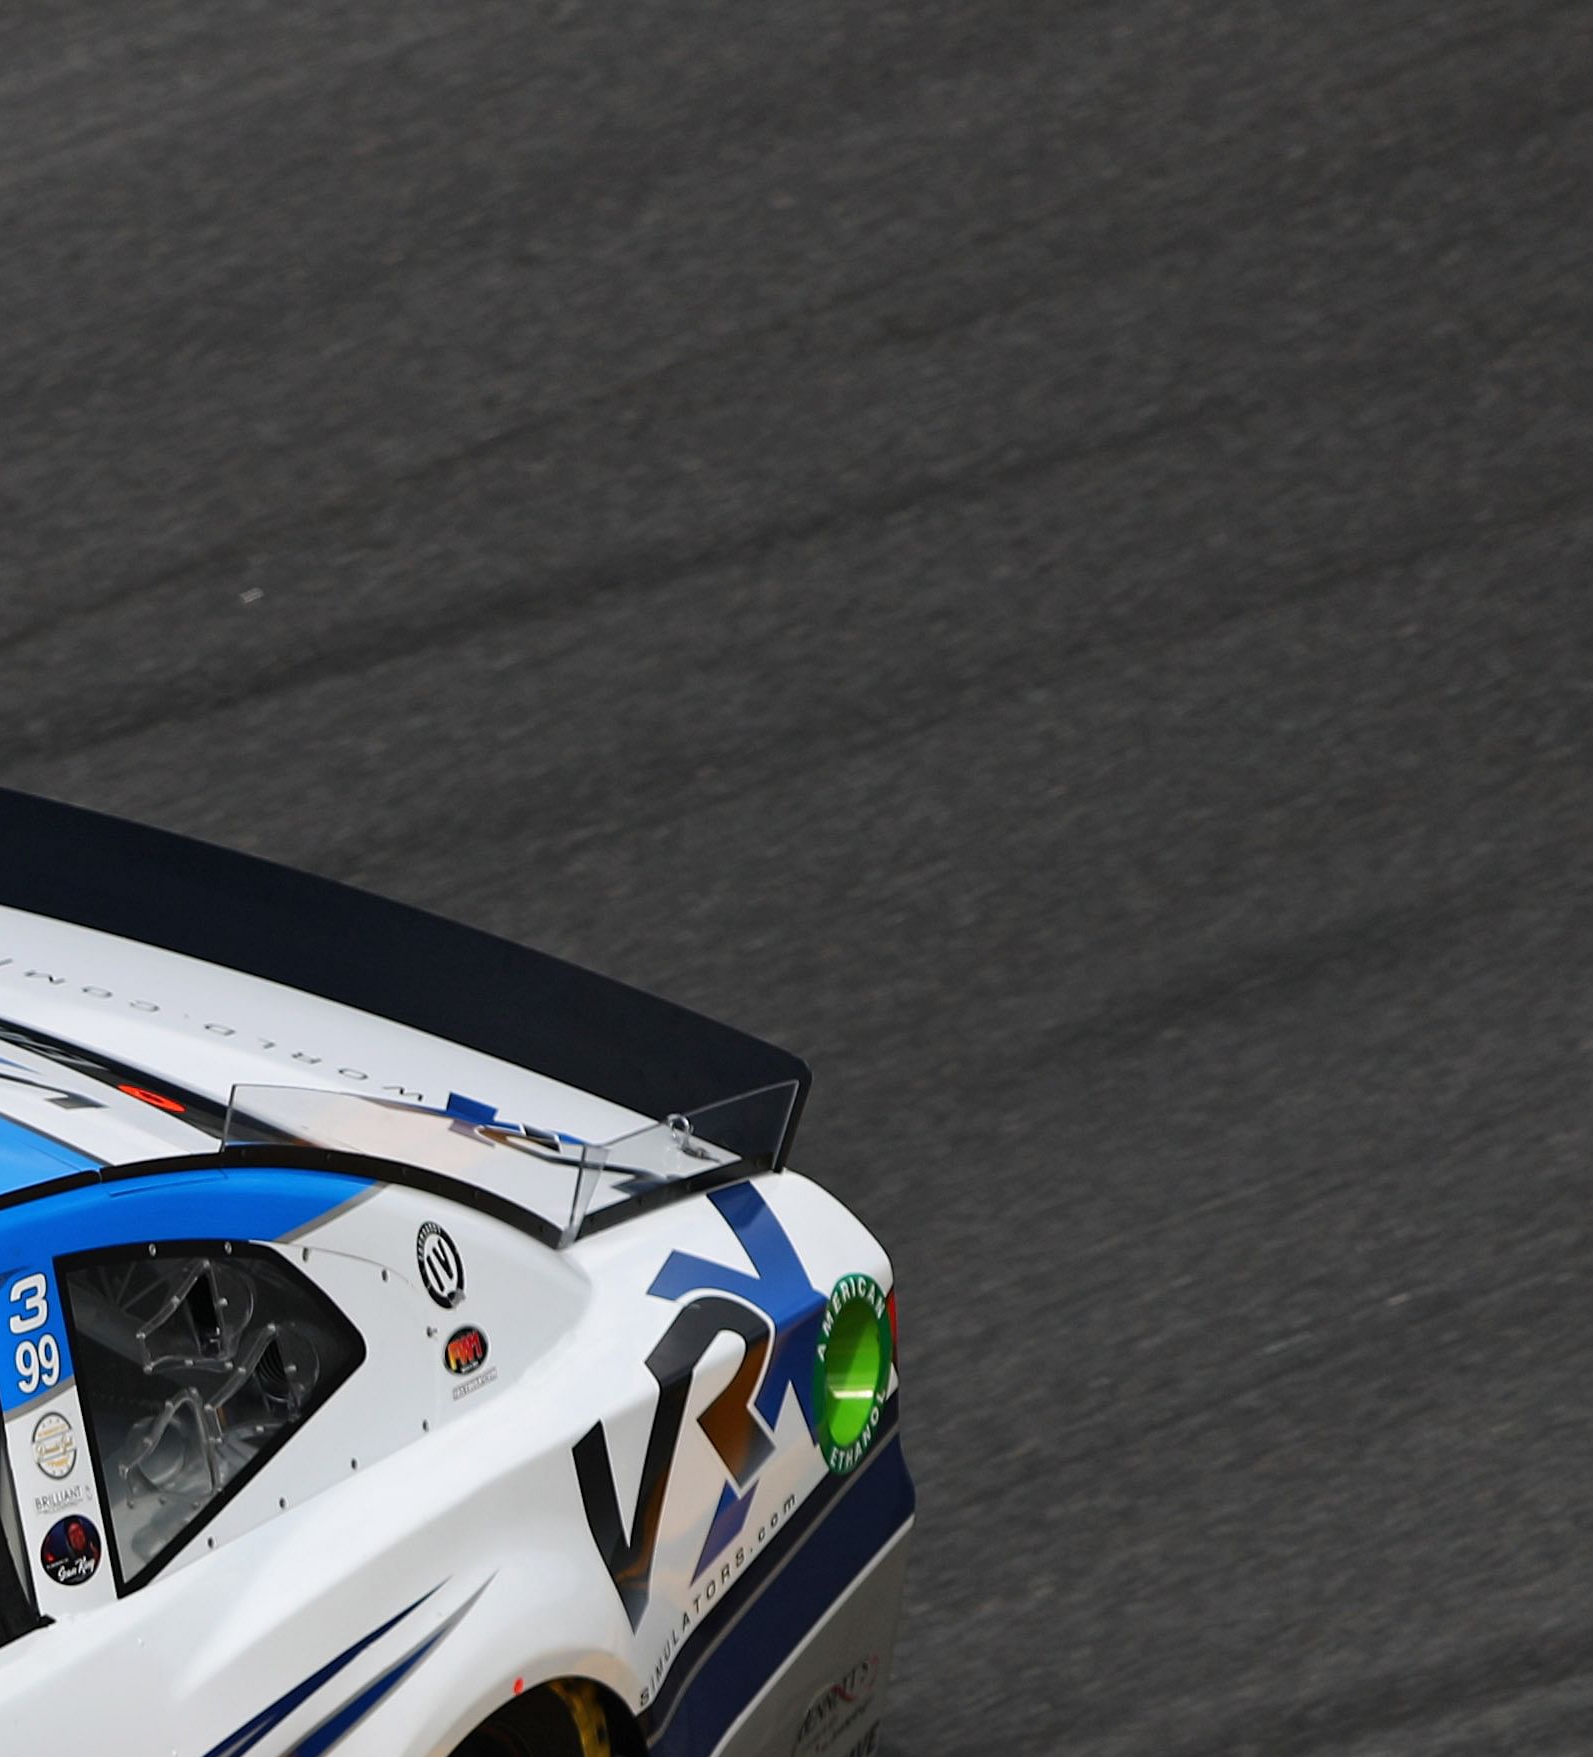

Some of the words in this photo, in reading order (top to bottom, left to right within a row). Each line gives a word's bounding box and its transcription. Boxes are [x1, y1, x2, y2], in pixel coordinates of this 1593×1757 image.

[8, 1272, 49, 1335] 3
[816, 1275, 887, 1363] AMERICAN
[14, 1333, 62, 1394] 99
[829, 1390, 887, 1472] ETHANOL
[34, 1485, 83, 1511] BRILLIANT
